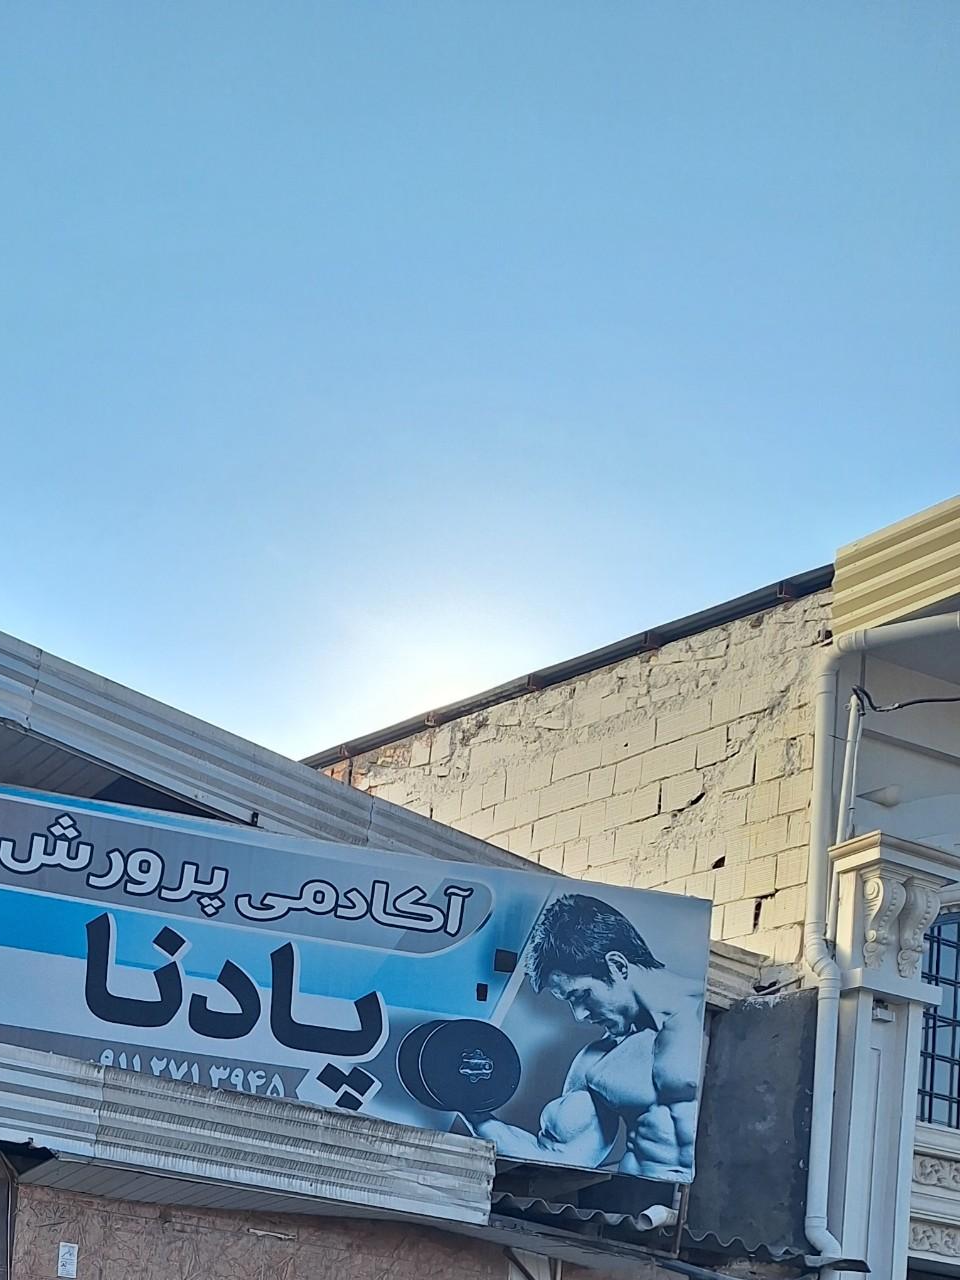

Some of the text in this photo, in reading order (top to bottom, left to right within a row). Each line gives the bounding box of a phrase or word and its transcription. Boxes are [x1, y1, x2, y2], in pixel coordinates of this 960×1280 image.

[235, 880, 474, 936] آکادمی
[85, 911, 383, 1111] پادنا
[90, 1049, 141, 1072] ۹۱۱
[150, 1056, 200, 1084] ۲۷۱
